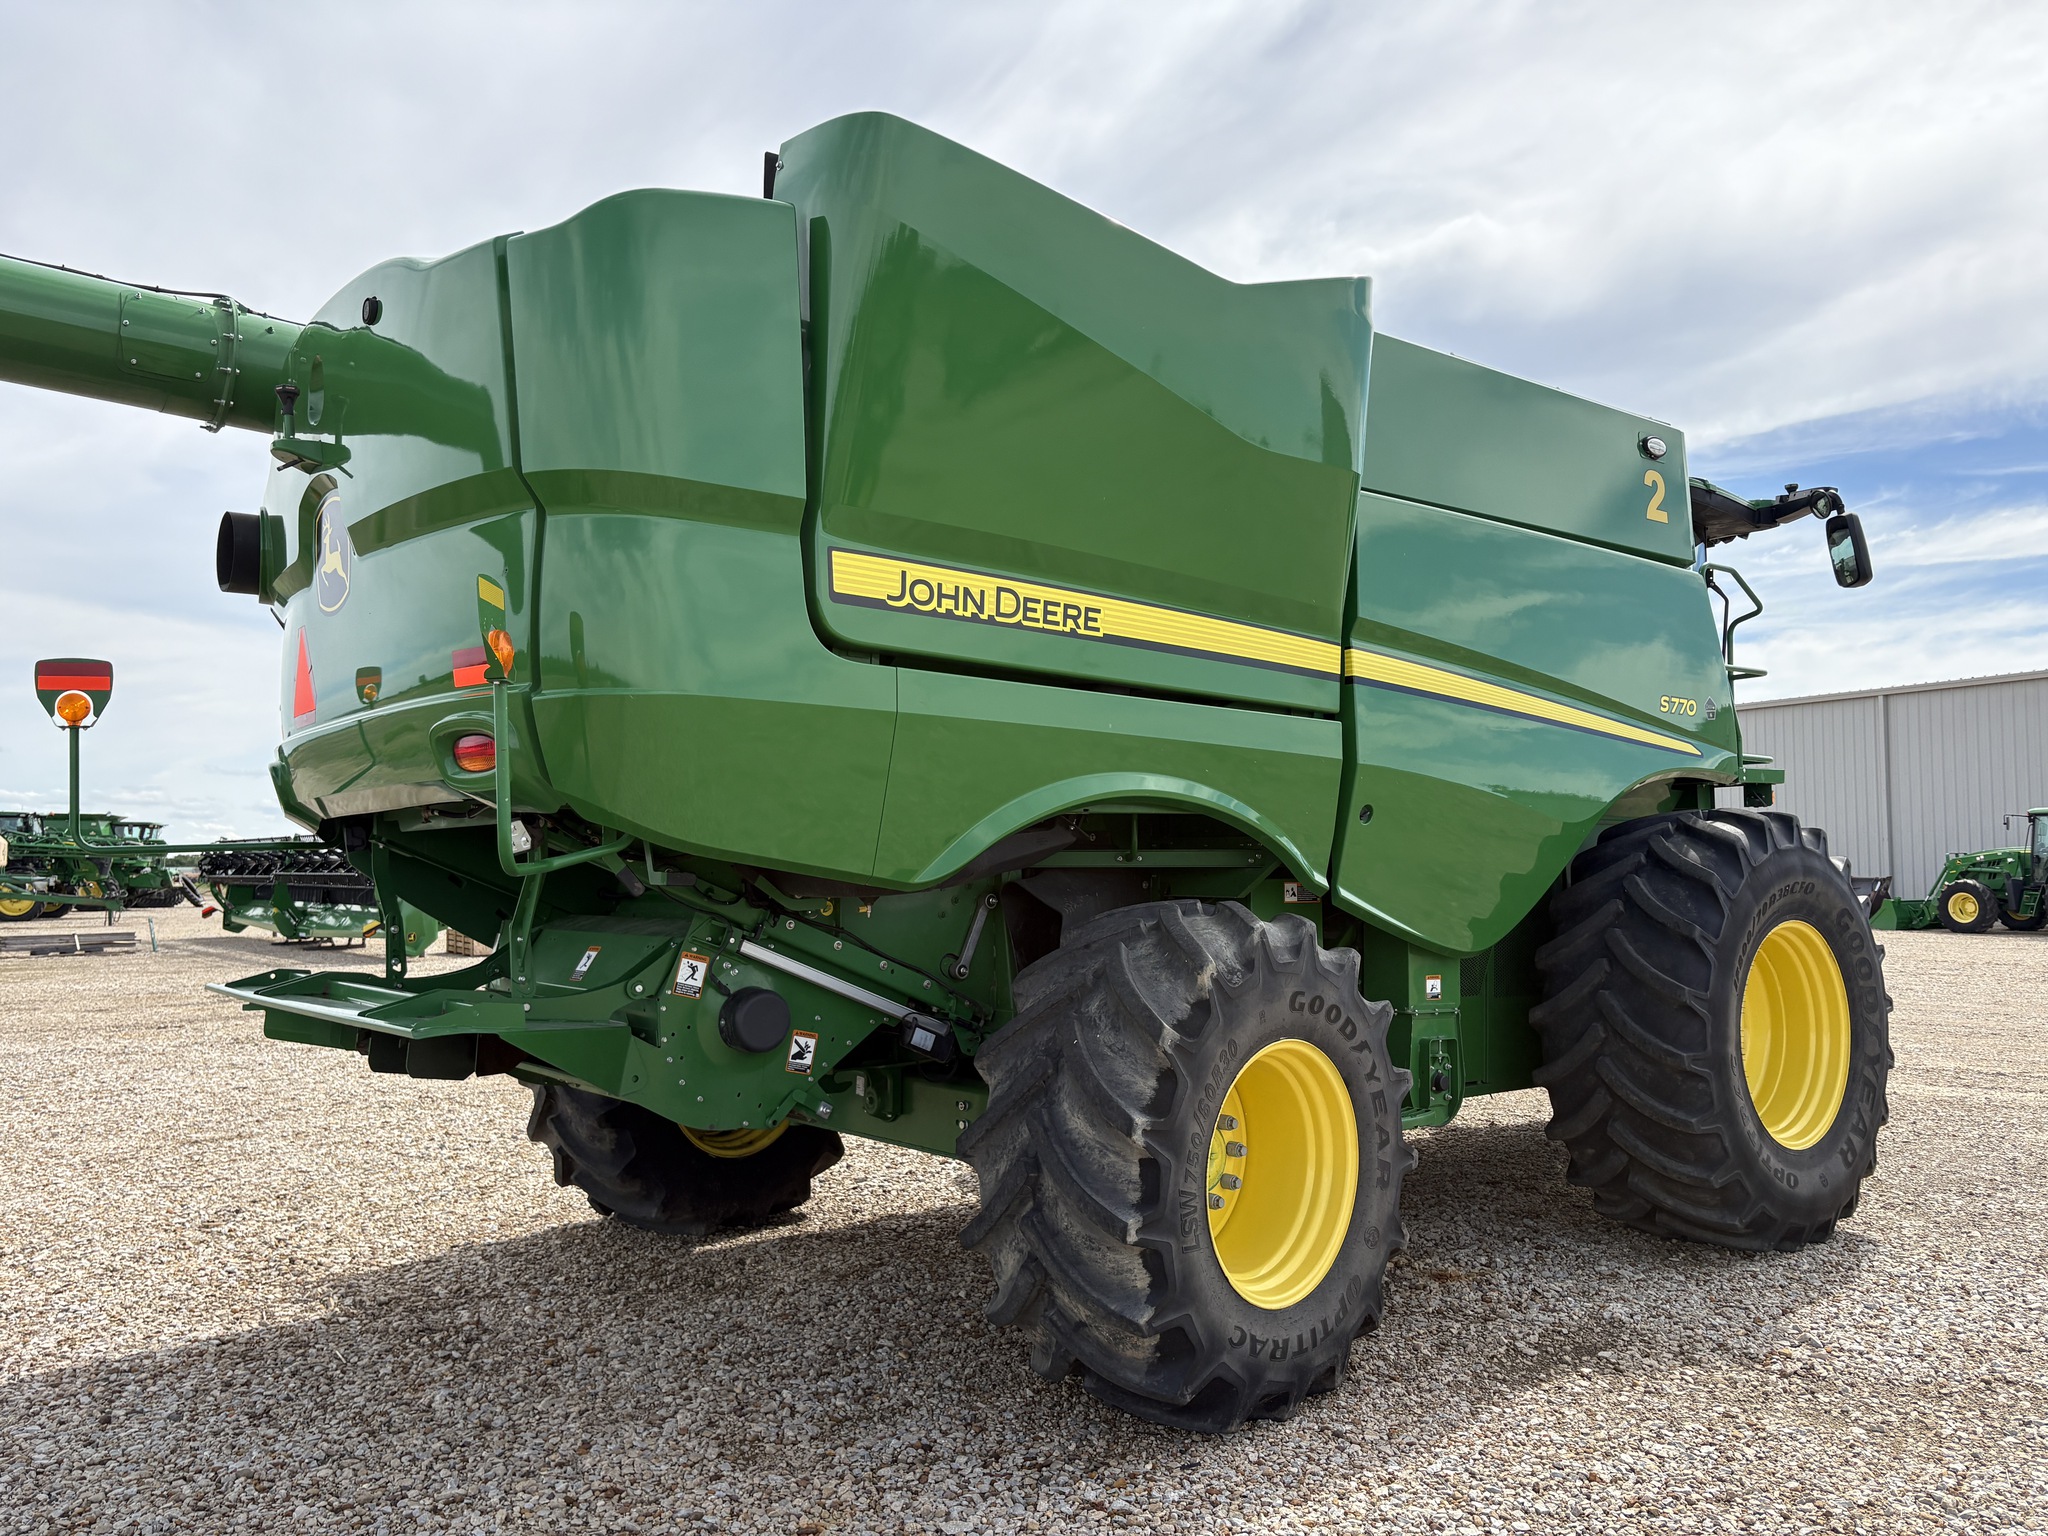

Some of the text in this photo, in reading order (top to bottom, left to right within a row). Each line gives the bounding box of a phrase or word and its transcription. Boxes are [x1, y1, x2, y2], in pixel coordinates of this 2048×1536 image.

[1643, 469, 1669, 524] 2
[885, 570, 1103, 635] JOHN DEERE
[1660, 695, 1697, 717] S770
[1835, 907, 1880, 1172] GOODYEAR
[1288, 990, 1391, 1192] GOODYEAR
[1178, 1037, 1239, 1255] LSW 750/60R30
[1228, 1273, 1362, 1363] OPTITRAC
